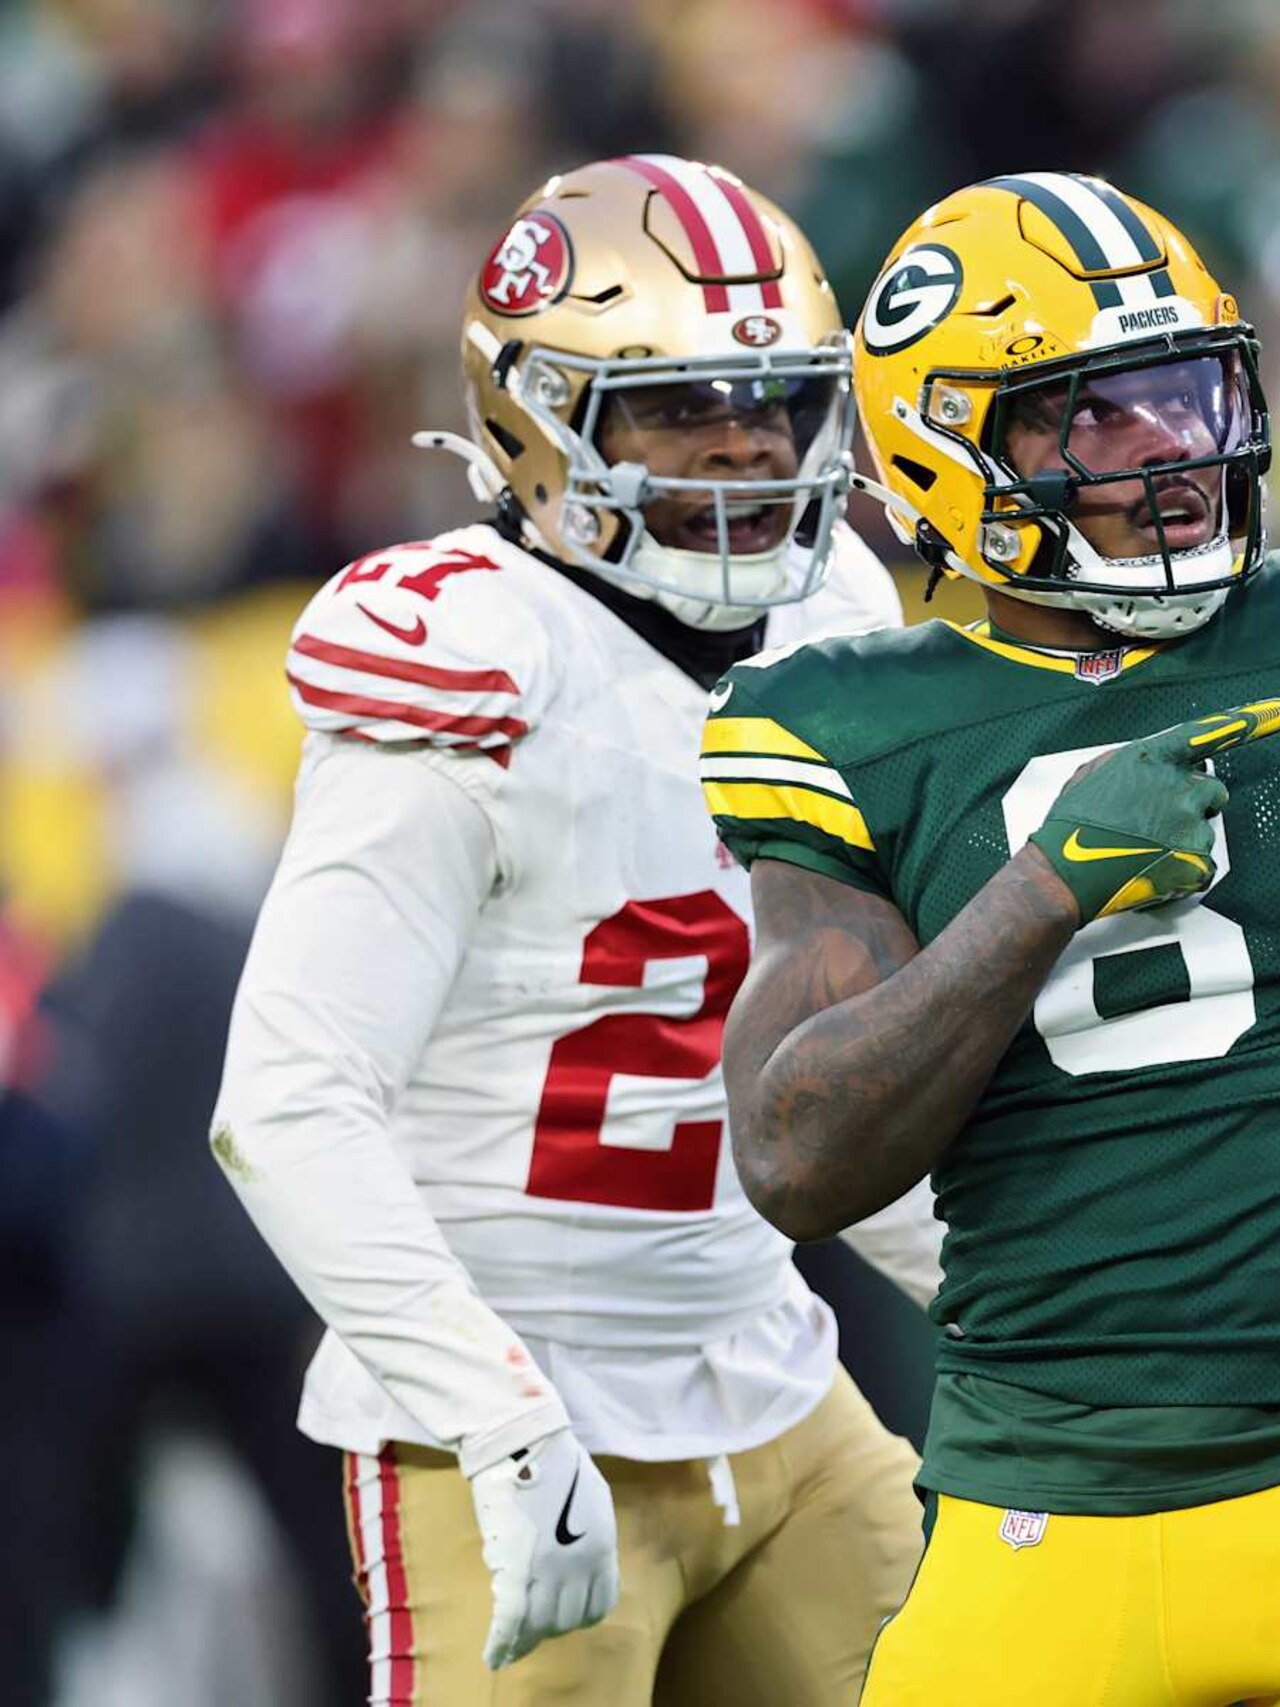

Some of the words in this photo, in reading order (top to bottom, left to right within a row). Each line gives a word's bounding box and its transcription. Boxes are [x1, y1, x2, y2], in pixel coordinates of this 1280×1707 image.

[862, 246, 960, 352] G
[1118, 306, 1179, 333] PACKERS
[1080, 657, 1117, 676] NFL
[1001, 741, 1256, 1076] 8
[1006, 1516, 1038, 1538] NFL
